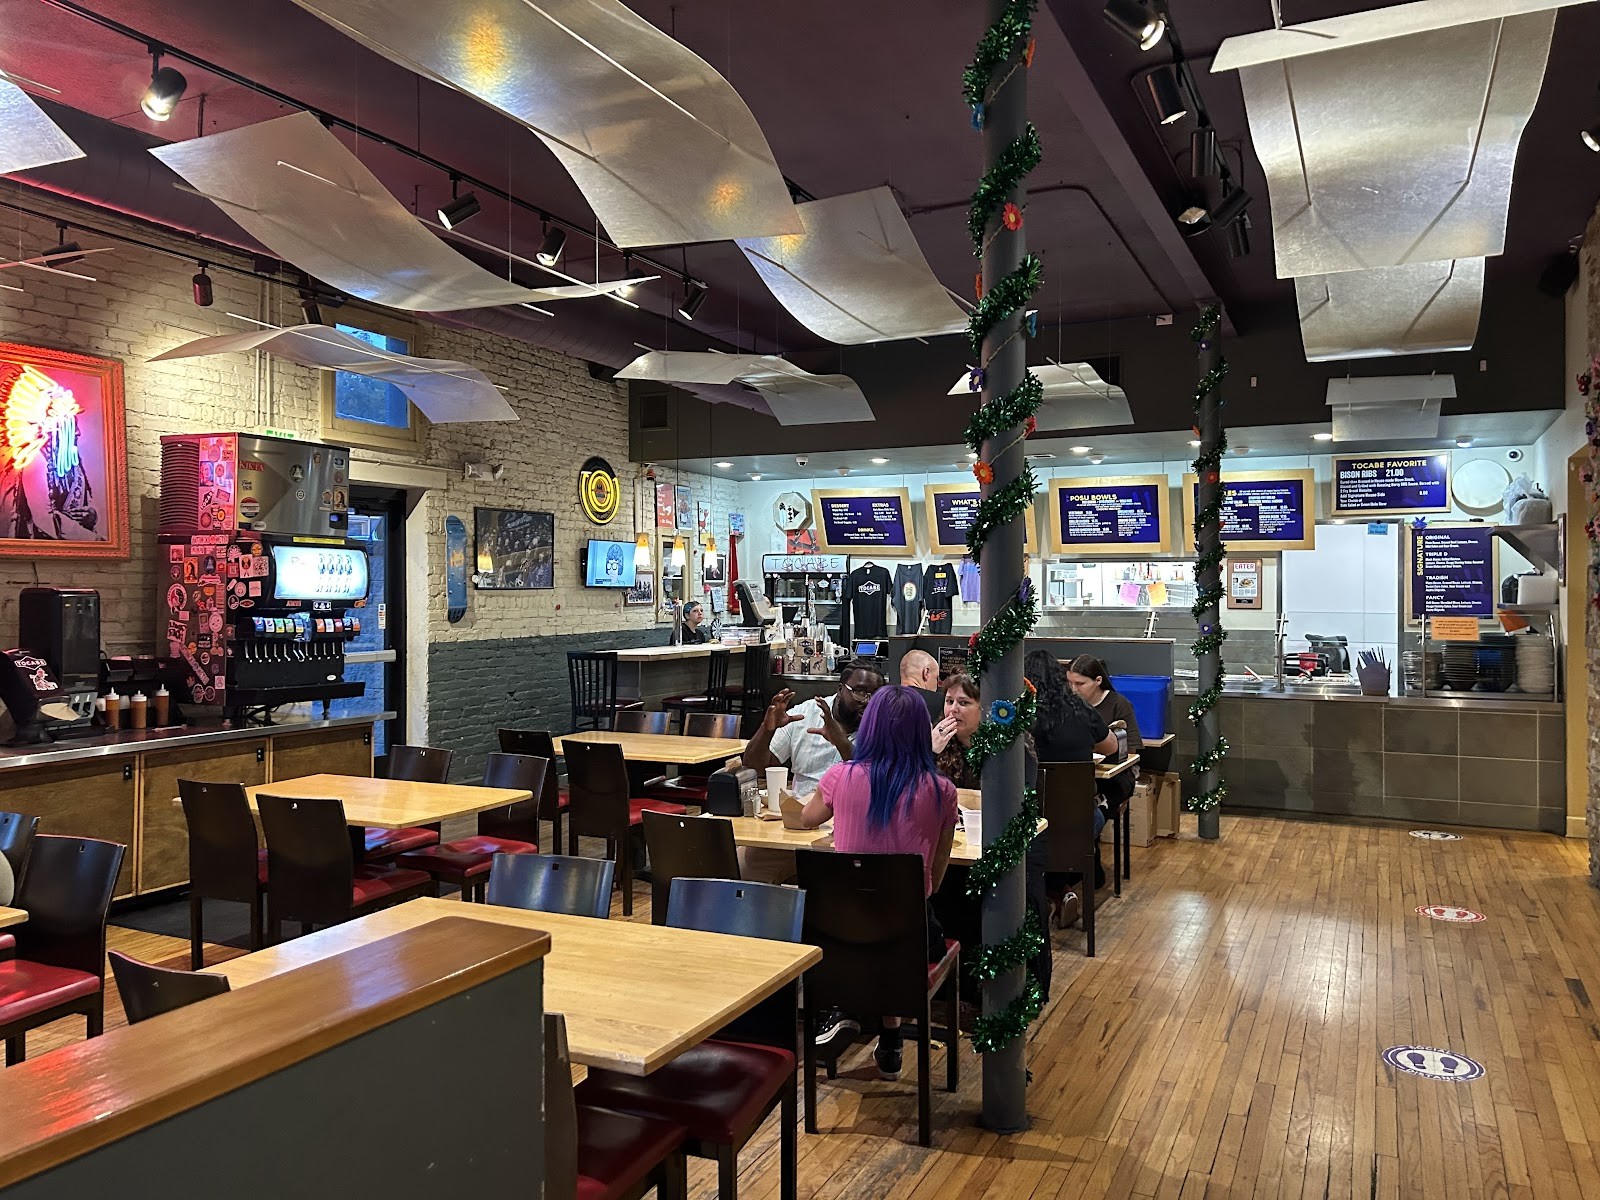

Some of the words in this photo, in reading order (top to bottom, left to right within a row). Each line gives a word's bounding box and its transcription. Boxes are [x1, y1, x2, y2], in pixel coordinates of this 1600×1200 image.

[1352, 462, 1384, 470] TOCABE
[1387, 459, 1427, 468] FAVORITE
[1340, 471, 1360, 479] BISON
[1361, 470, 1377, 478] RIBS
[1385, 468, 1404, 477] 21.00
[1091, 493, 1117, 501] BOWLS
[771, 557, 840, 570] TOCABE
